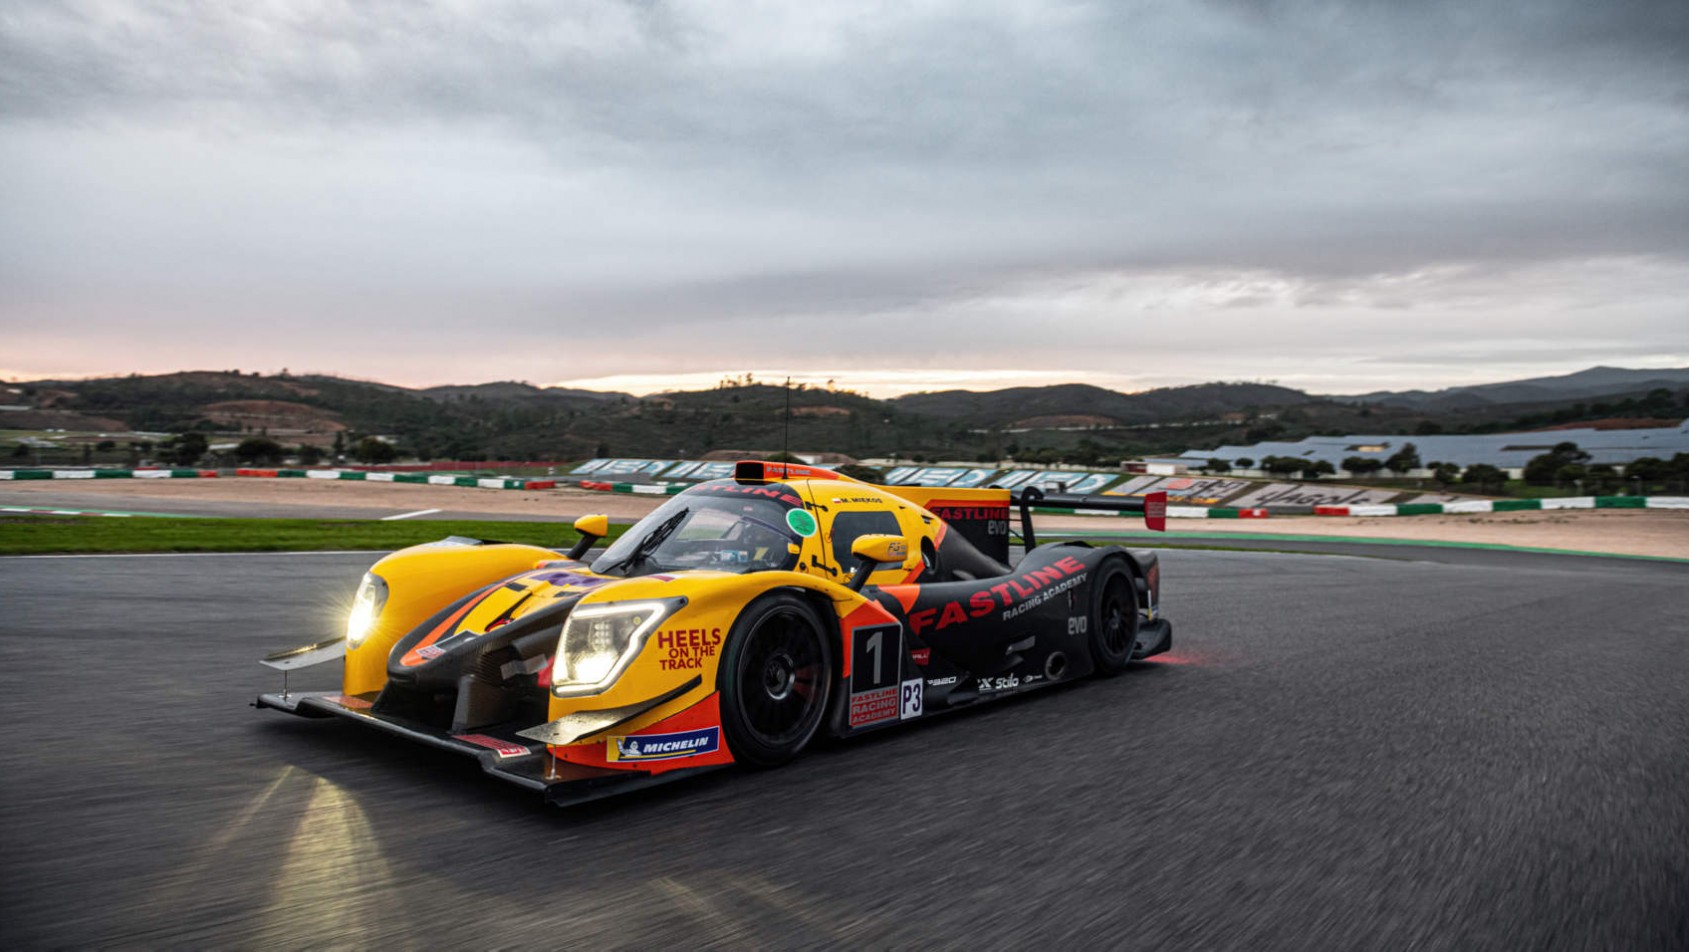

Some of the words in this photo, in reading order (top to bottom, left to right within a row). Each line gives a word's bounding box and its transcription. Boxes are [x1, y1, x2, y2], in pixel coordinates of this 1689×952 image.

[909, 556, 1086, 636] FASTLINE
[1002, 596, 1041, 621] RACING
[1043, 573, 1087, 601] ACADEMY
[1068, 616, 1087, 635] evo
[658, 628, 721, 649] HEELS
[669, 647, 689, 659] ON
[693, 645, 716, 657] THE
[866, 631, 883, 685] 1
[660, 657, 703, 670] TRACK
[995, 672, 1019, 689] Stilo
[851, 688, 897, 703] FASTLINE
[903, 683, 921, 715] P3
[852, 698, 896, 715] RACING
[852, 708, 896, 724] ACADEMY
[643, 737, 709, 753] MICHELIN
